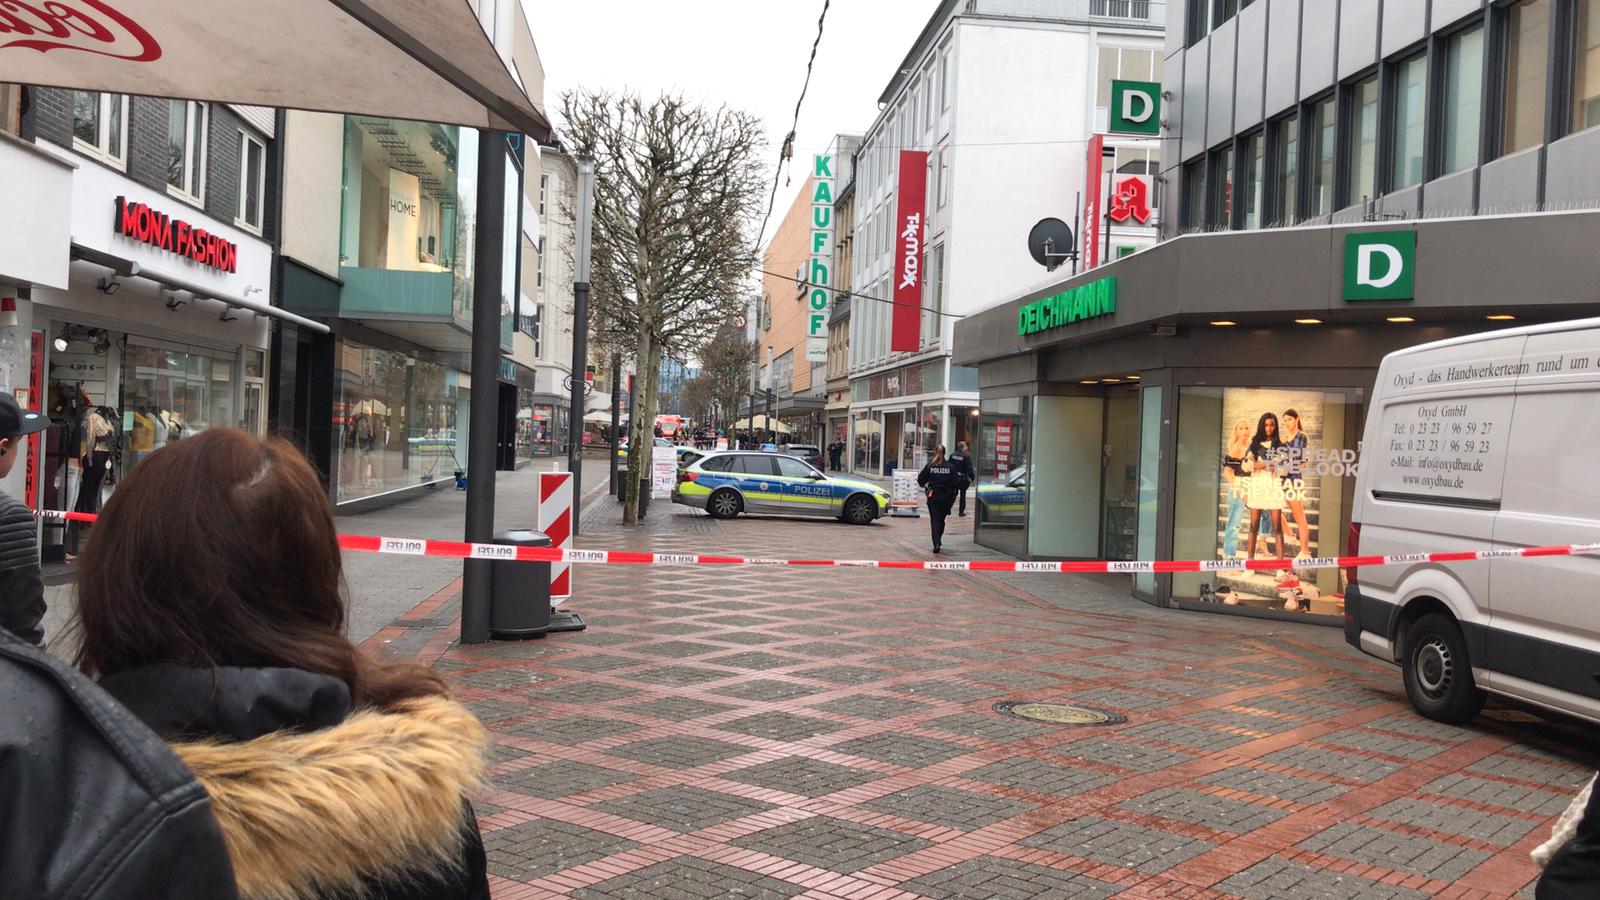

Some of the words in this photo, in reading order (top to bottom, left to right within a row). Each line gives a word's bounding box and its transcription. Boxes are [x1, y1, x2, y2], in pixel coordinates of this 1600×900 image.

[1122, 89, 1154, 123] D
[390, 199, 417, 217] HOME
[116, 196, 173, 252] MONA
[176, 220, 237, 273] FASHION
[1357, 243, 1403, 288] D
[1018, 276, 1117, 336] DEICHMANN
[1393, 372, 1415, 389] Oxyd
[1427, 370, 1442, 383] das
[1446, 362, 1530, 381] Handwerkerteam
[1536, 355, 1563, 373] rund
[1570, 358, 1589, 369] um
[1418, 406, 1438, 420] Oxyd
[1441, 405, 1467, 417] GmbH
[1409, 423, 1415, 434] 0
[1418, 423, 1427, 434] 23
[1430, 423, 1440, 434] 23
[1452, 423, 1462, 434] 96
[1465, 423, 1476, 435] 59
[1481, 422, 1492, 435] 27
[1407, 440, 1413, 451] 0
[1416, 439, 1425, 451] 23
[1429, 440, 1438, 451] 23
[1450, 440, 1460, 452] 96
[1464, 440, 1475, 453] 59
[1479, 440, 1490, 453] 23
[1266, 446, 1356, 463] #SPREAD
[1307, 461, 1359, 477] LOOK
[1417, 456, 1484, 472] info@oxydbau.de
[1402, 474, 1464, 489] www.oxydbau.de
[794, 485, 830, 496] POLIZEI
[1265, 489, 1307, 501] LOOK
